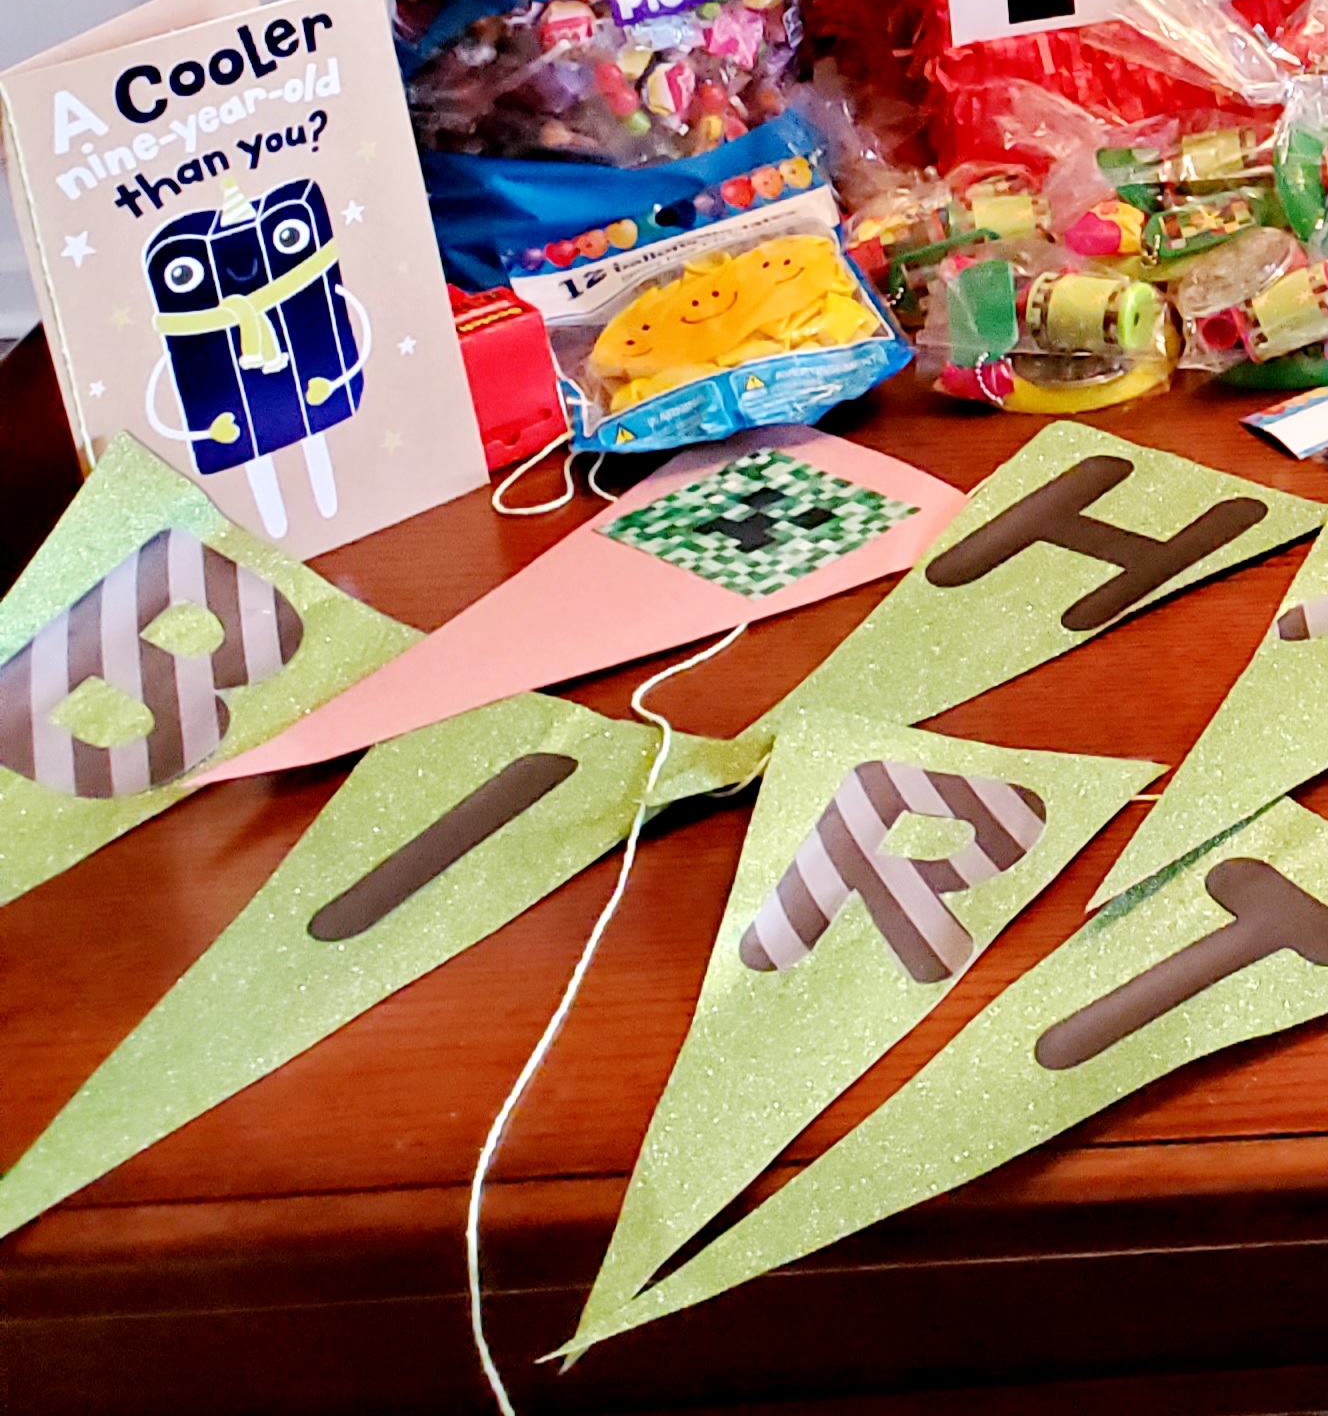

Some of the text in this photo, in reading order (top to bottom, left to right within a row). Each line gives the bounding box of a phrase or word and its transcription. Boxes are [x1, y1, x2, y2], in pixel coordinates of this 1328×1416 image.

[52, 11, 333, 155] A Cooler
[55, 58, 341, 199] nine-year-old
[115, 110, 328, 219] than you?
[558, 267, 608, 301] 12
